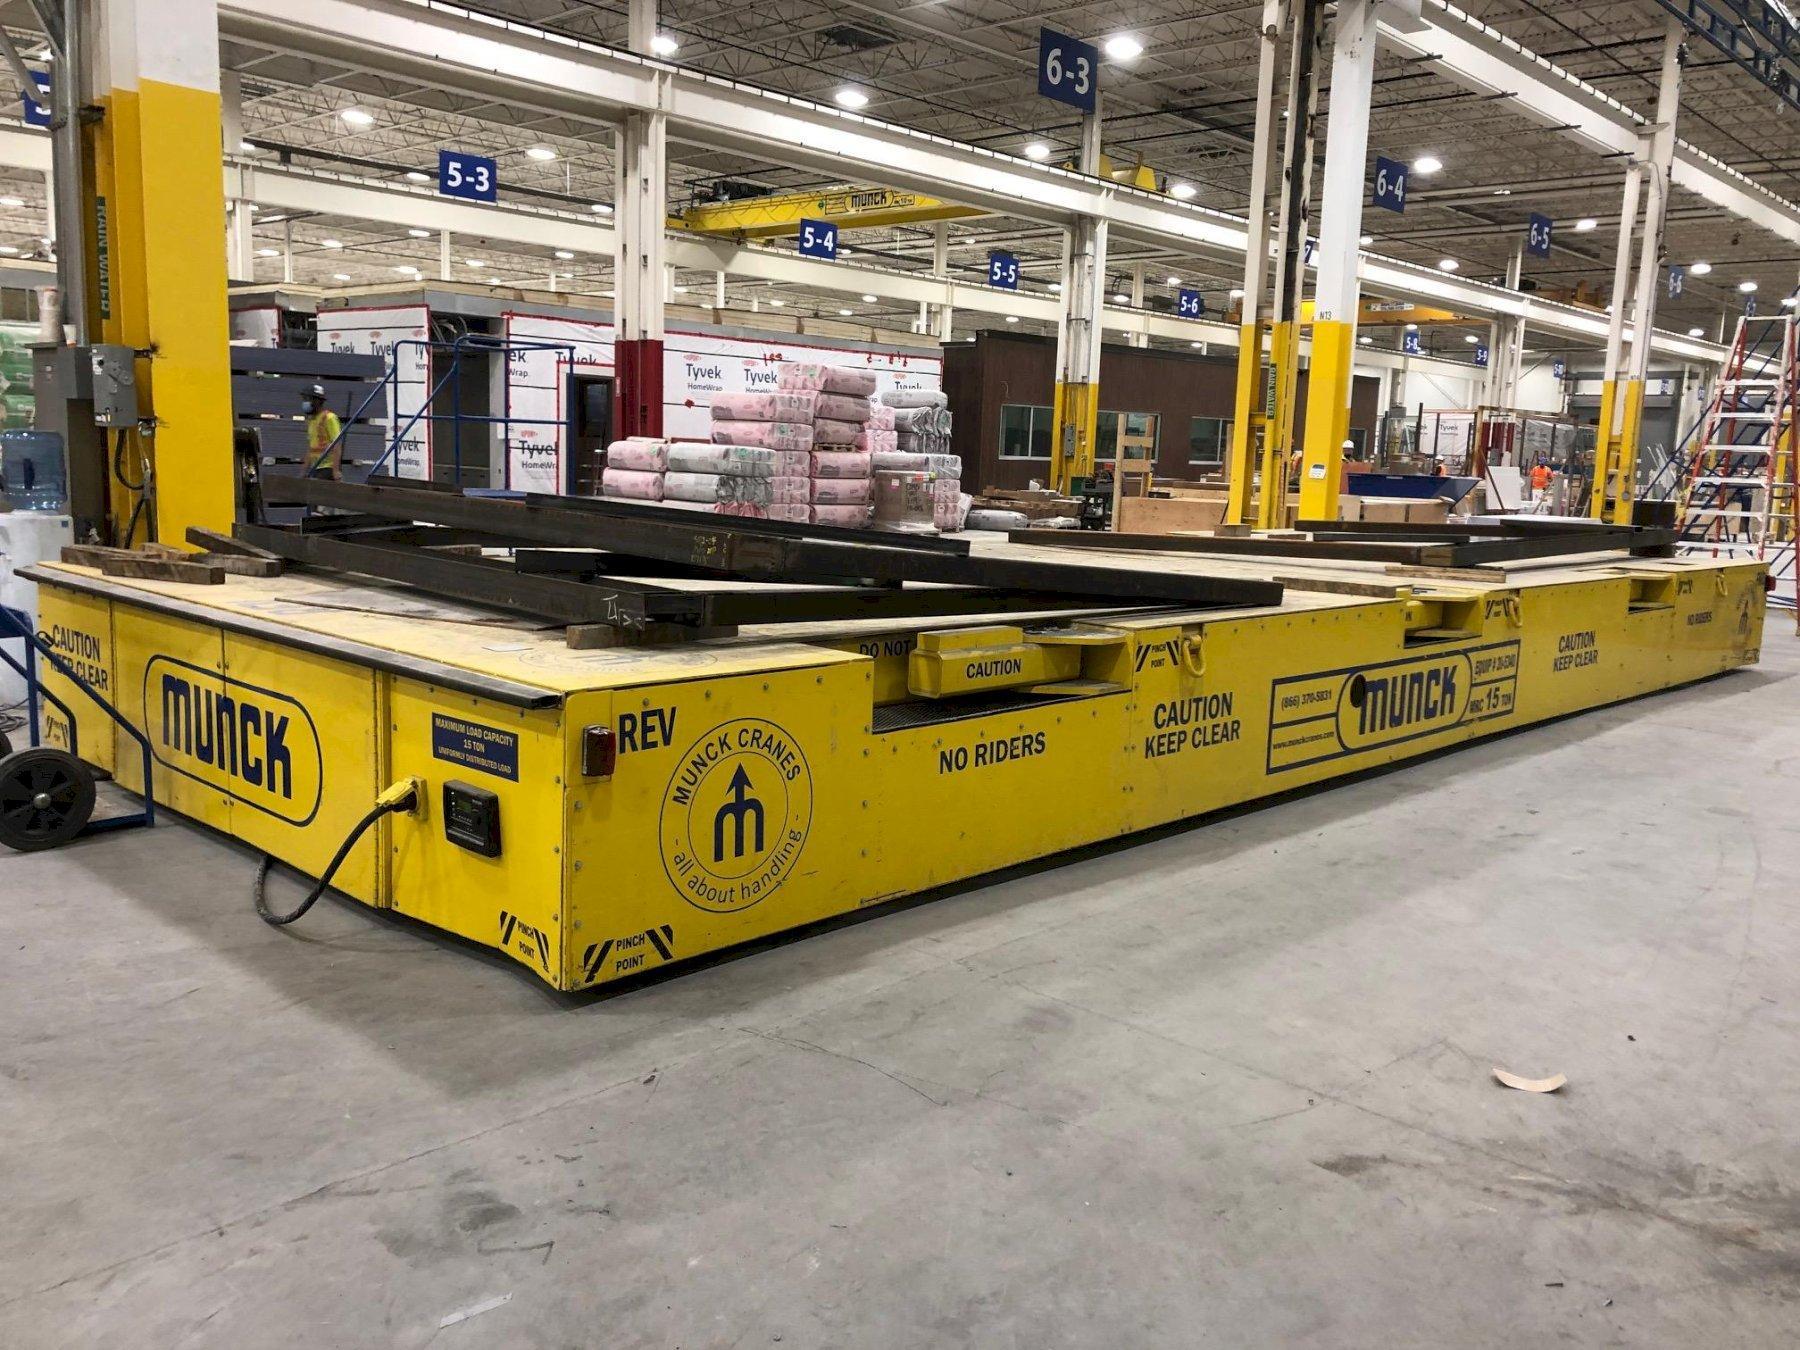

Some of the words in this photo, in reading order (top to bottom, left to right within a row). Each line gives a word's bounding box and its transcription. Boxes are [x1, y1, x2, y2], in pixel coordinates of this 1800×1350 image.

[1047, 48, 1090, 95] 6-3
[447, 161, 490, 192] 5-3
[1377, 169, 1404, 202] 6-4
[803, 226, 834, 252] 5-4
[1530, 223, 1550, 249] 6-5
[992, 261, 1016, 283] 5-5
[1180, 295, 1199, 314] 5-6
[1319, 310, 1332, 321] N13
[1406, 337, 1418, 351] 5-8
[1477, 349, 1488, 362] 5-9
[686, 363, 722, 381] Tyvek
[743, 368, 778, 386] Tyvek
[53, 624, 101, 663] CAUTION
[859, 642, 880, 659] DO
[884, 639, 911, 657] NOT
[1151, 643, 1167, 653] PINCH
[1558, 630, 1597, 653] CAUTION
[965, 658, 1022, 679] CAUTION
[1553, 655, 1574, 672] KEEP
[1574, 649, 1599, 667] CLEAR
[1153, 691, 1233, 729] CAUTION
[1358, 664, 1458, 735] MUNCK
[1486, 687, 1500, 710] 15
[162, 673, 292, 800] MUNCK
[435, 717, 466, 733] MAXIMUM
[466, 726, 483, 739] LOAD
[483, 730, 514, 747] CAPACITY
[619, 706, 677, 754] REV
[1144, 730, 1187, 759] KEEP
[1191, 719, 1241, 749] CLEAR
[463, 739, 473, 750] 15
[473, 741, 485, 753] TON
[939, 746, 969, 775] NO
[973, 731, 1046, 768] RIDERS
[438, 746, 466, 761] UNIFORMLY
[466, 754, 497, 770] DISTRIBUTED
[497, 762, 512, 774] LOAD
[672, 732, 733, 806] MUNCK
[738, 728, 801, 781] CRANES
[673, 851, 695, 877] all
[687, 874, 735, 904] about
[740, 828, 802, 900] handling
[517, 920, 534, 940] PINCH
[518, 941, 535, 959] POINT
[615, 933, 646, 952] PINCH
[615, 953, 646, 973] POINT
